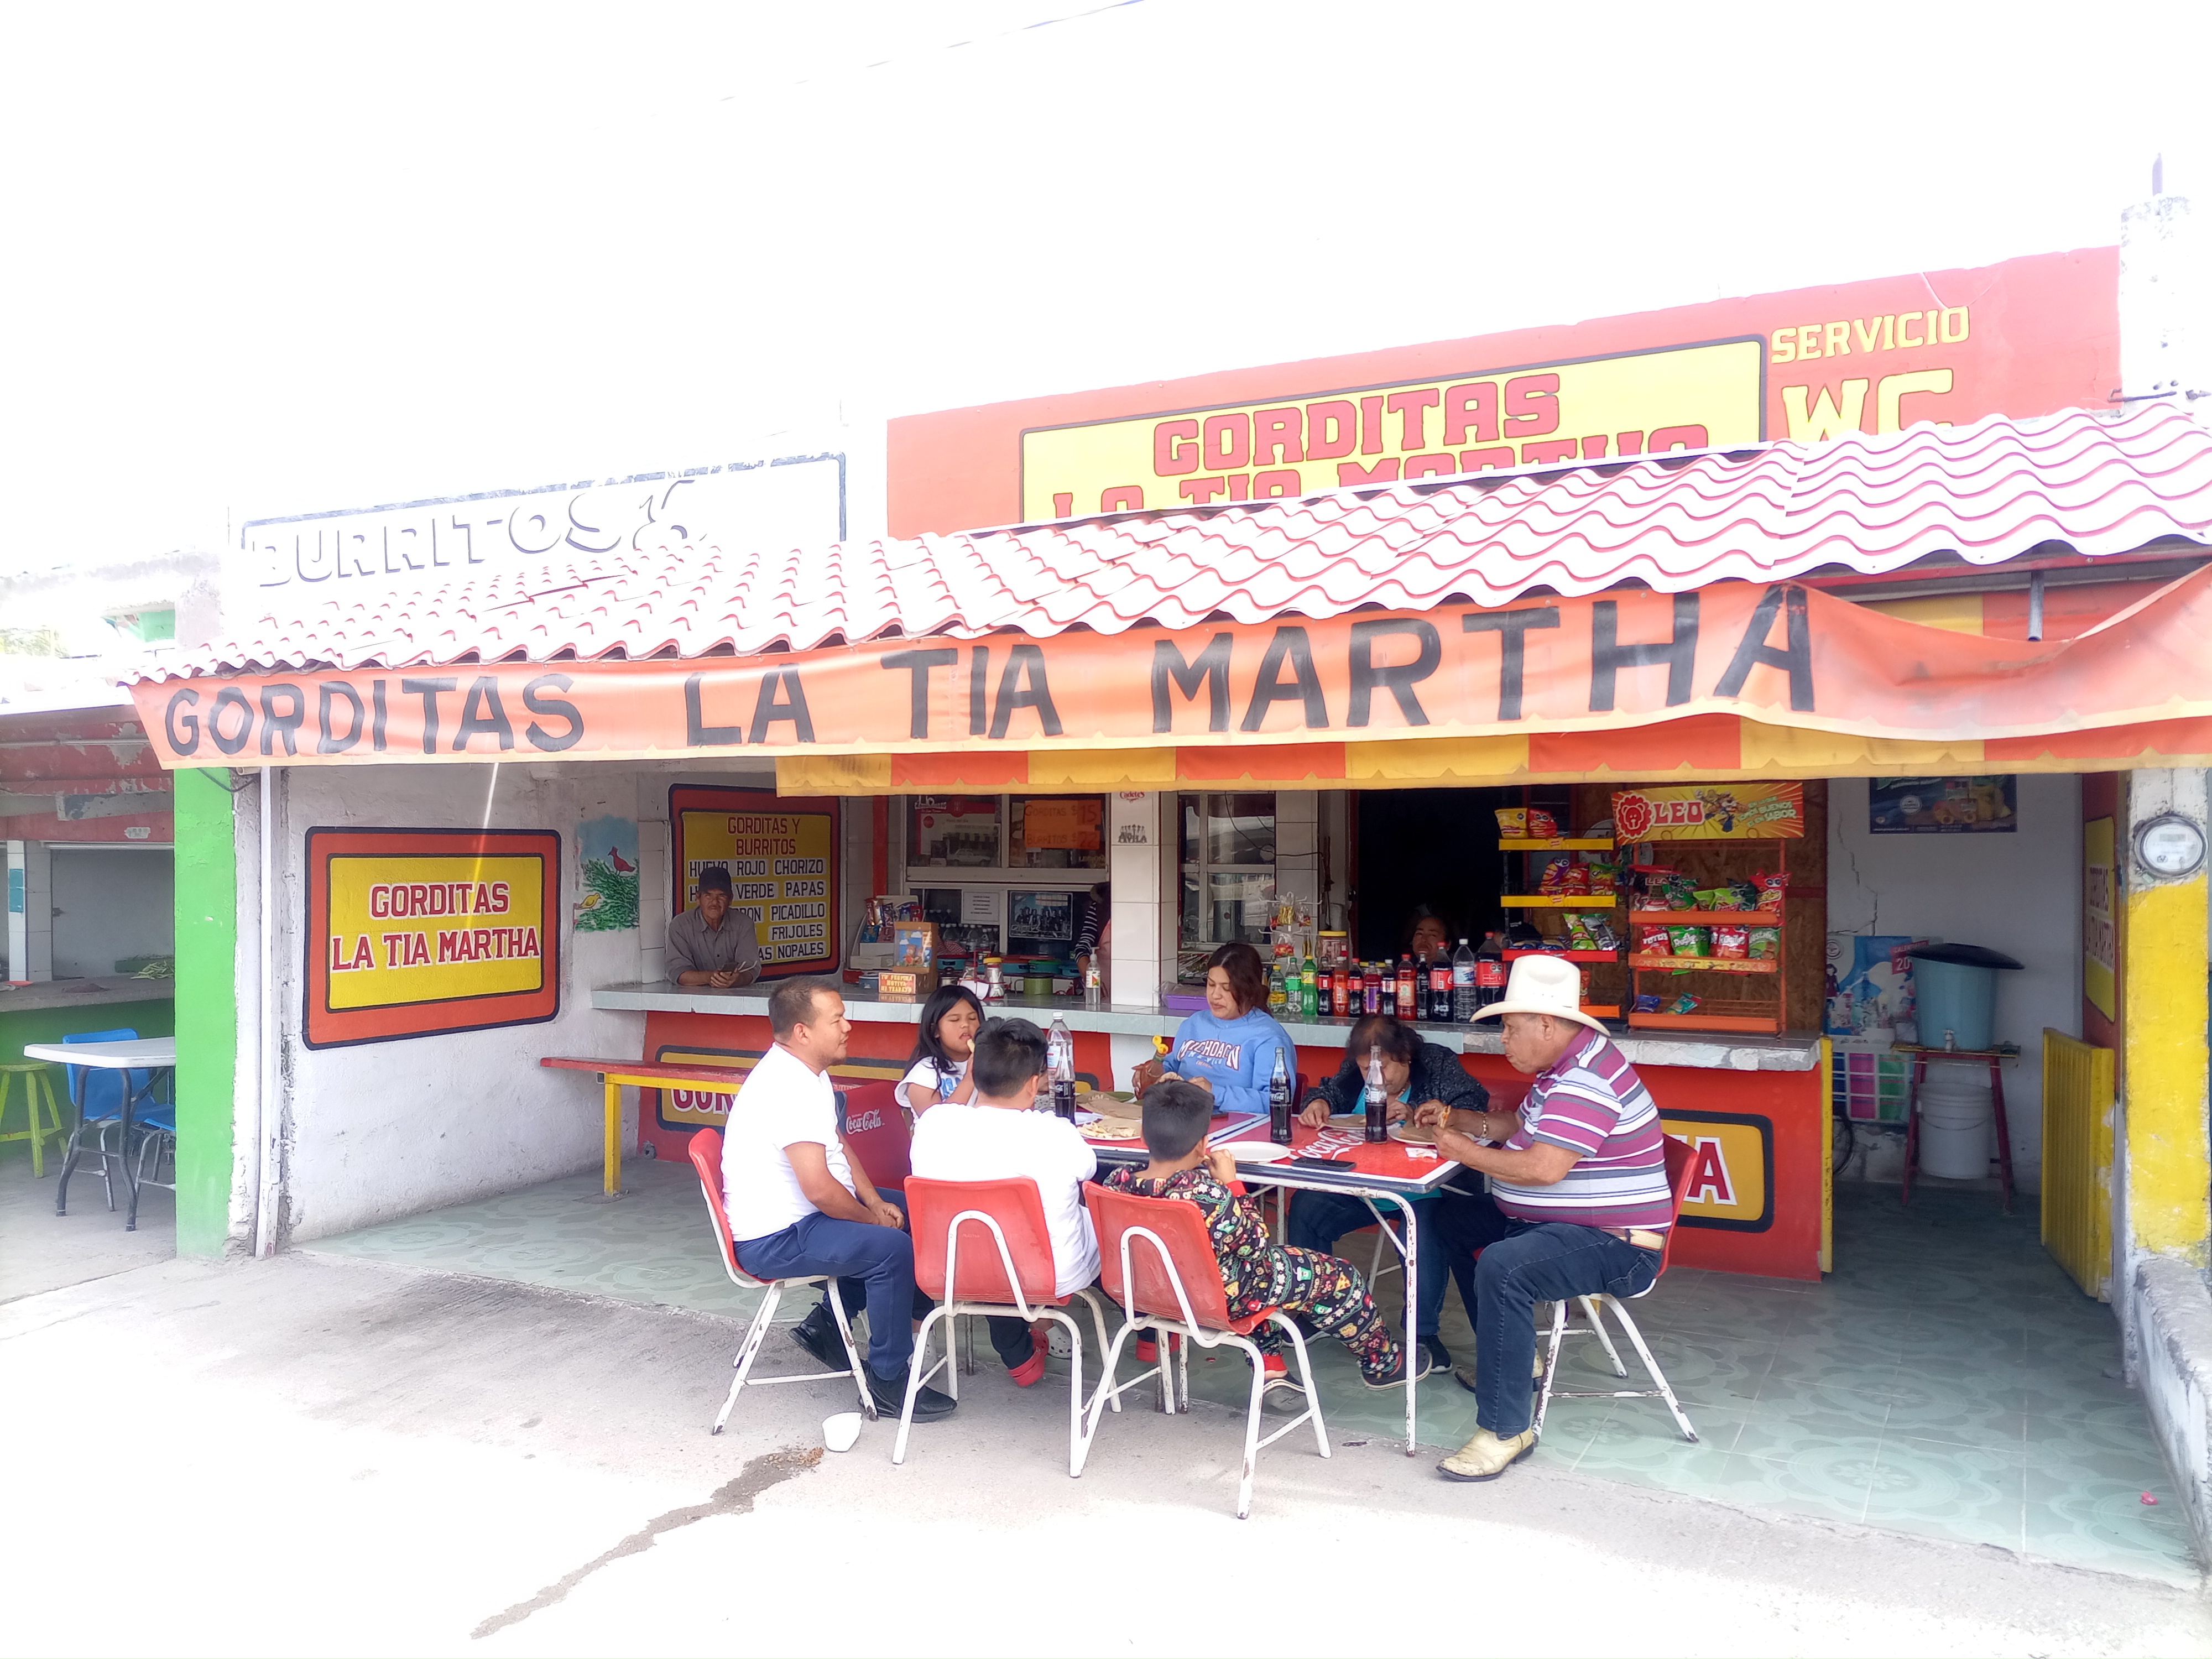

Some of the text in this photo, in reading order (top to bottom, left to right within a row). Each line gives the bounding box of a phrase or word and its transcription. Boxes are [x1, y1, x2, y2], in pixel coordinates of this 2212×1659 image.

[1771, 306, 1969, 364] SERVICIO
[1781, 368, 1953, 442] WC
[1154, 373, 1560, 477] GORDITAS
[253, 491, 622, 587] BURRITOS
[164, 582, 1816, 756] GORDITAS LA TIA MARTHA
[1025, 805, 1066, 816] GORDITAS
[1653, 801, 1704, 826] LEO
[728, 817, 801, 834] GORDITAS Y
[736, 838, 796, 856] BURRITOS
[1027, 833, 1067, 845] BURRITOS
[737, 860, 765, 875] ROJO
[775, 859, 824, 875] CHORIZO
[736, 881, 824, 900] VERDE PAPAS
[370, 882, 510, 919] GORDITAS
[771, 903, 825, 921] PICADILLO
[771, 924, 823, 940] FRIJOLES
[331, 926, 541, 972] LA TIA MARTHA
[778, 942, 824, 959] NOPALES
